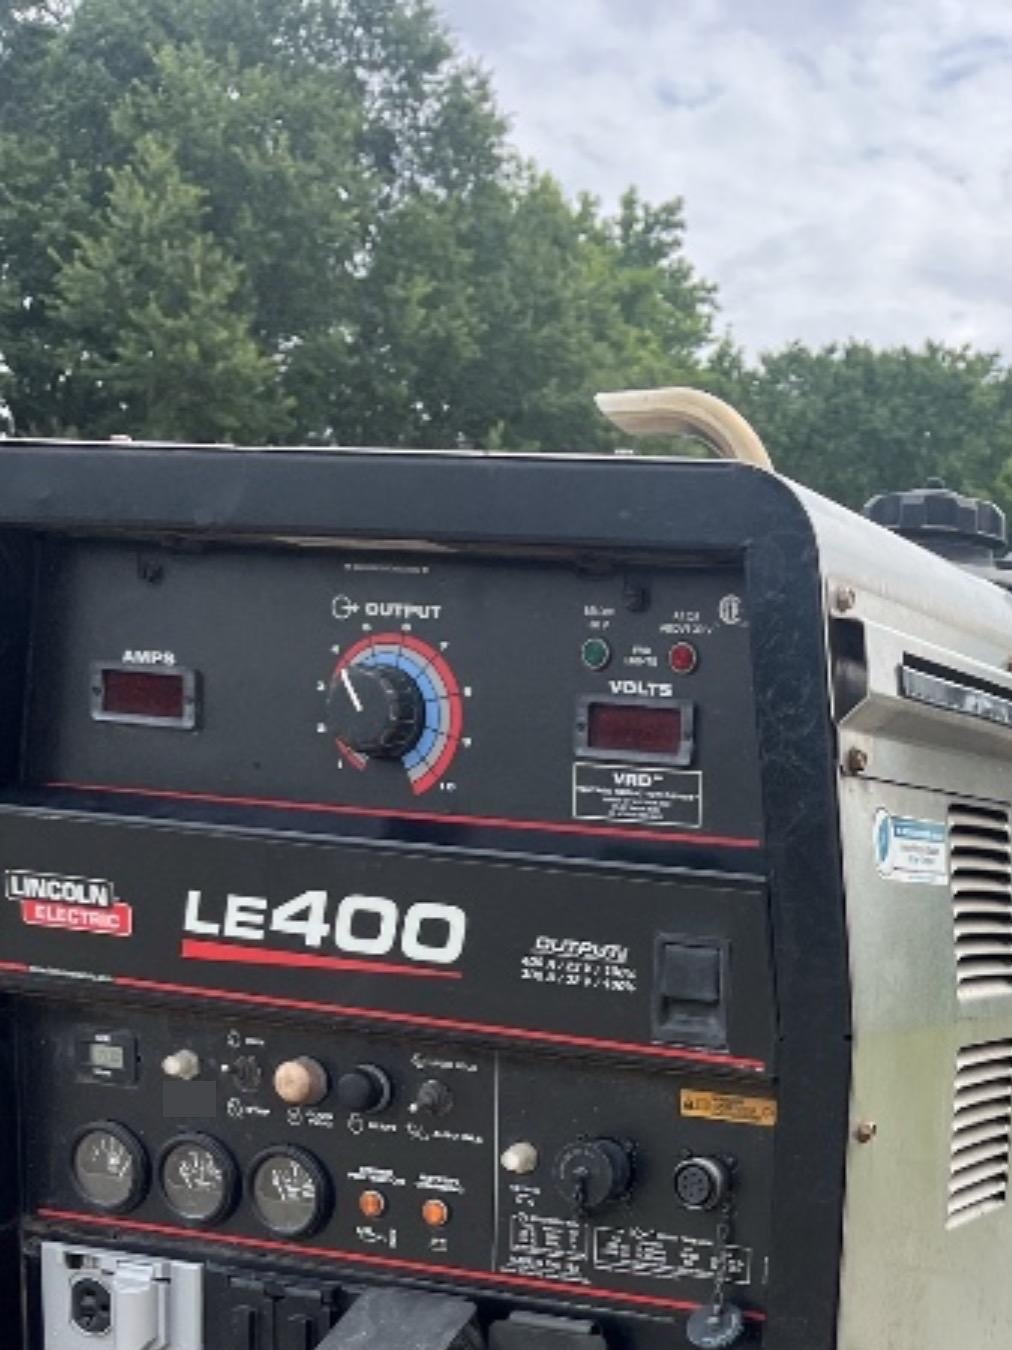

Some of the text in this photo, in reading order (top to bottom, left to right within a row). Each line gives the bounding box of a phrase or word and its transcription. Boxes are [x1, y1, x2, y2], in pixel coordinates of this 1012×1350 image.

[364, 601, 442, 619] OUTPUT
[121, 649, 177, 667] AMPS
[608, 680, 673, 697] VOLTS
[10, 874, 110, 907] LINCOLN
[34, 904, 120, 930] ELECTRIC
[184, 890, 466, 964] LE400
